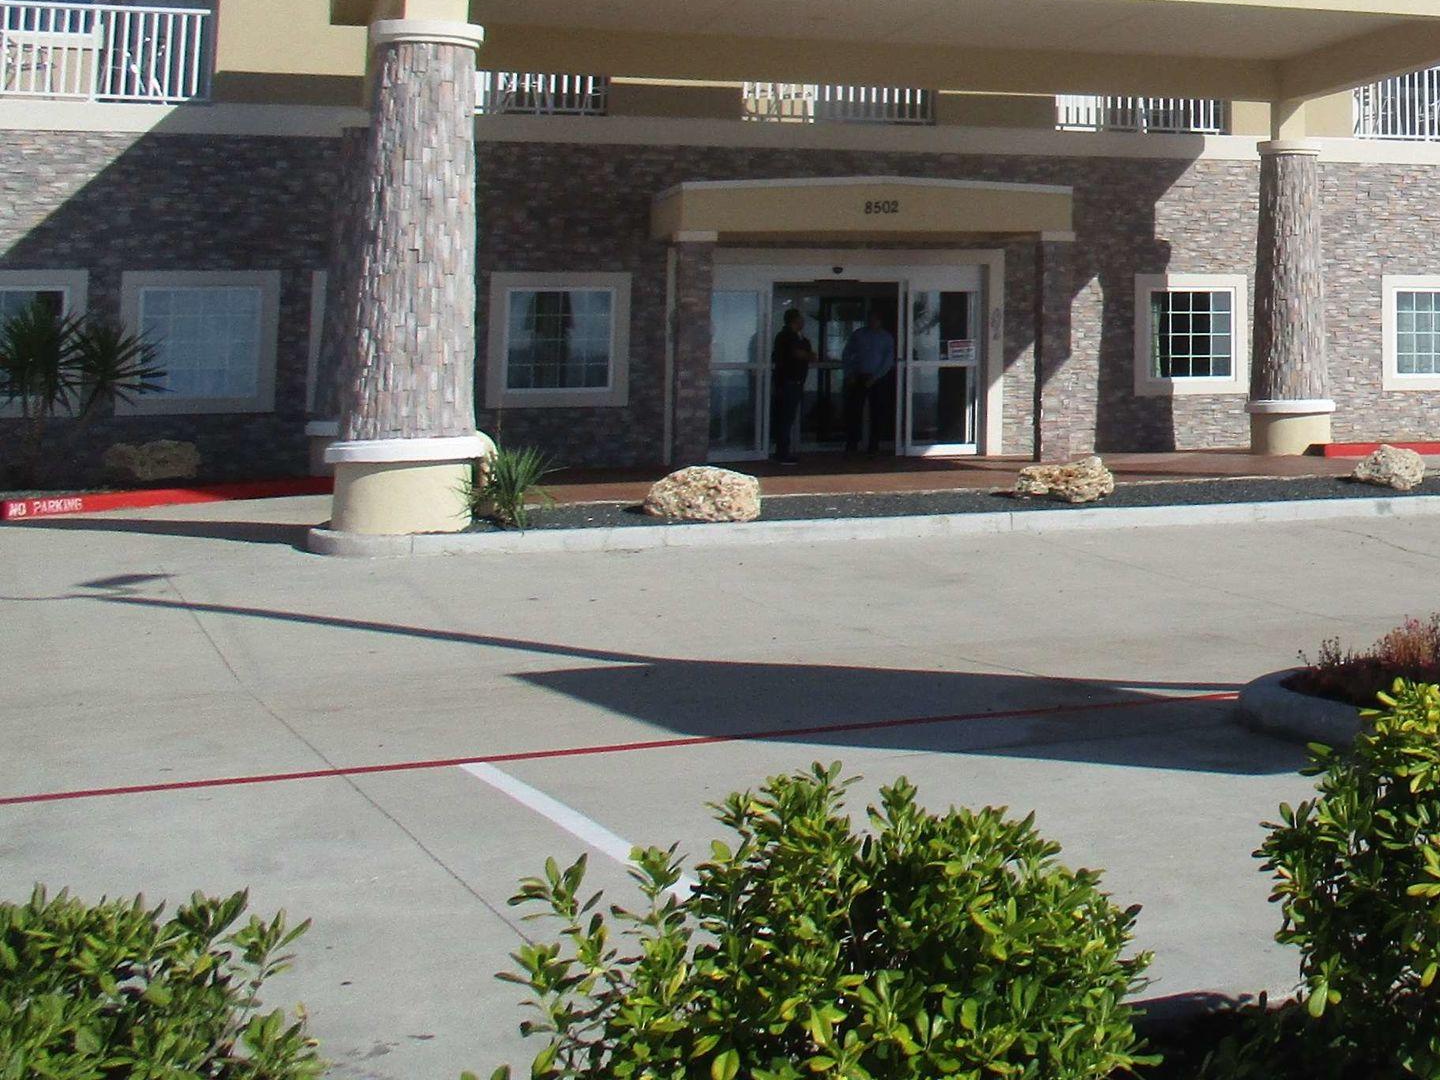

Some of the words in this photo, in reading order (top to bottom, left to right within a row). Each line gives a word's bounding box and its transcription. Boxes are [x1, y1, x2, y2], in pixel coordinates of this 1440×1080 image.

[864, 200, 899, 214] 8502
[8, 502, 26, 517] NO
[32, 498, 82, 515] PARKING
